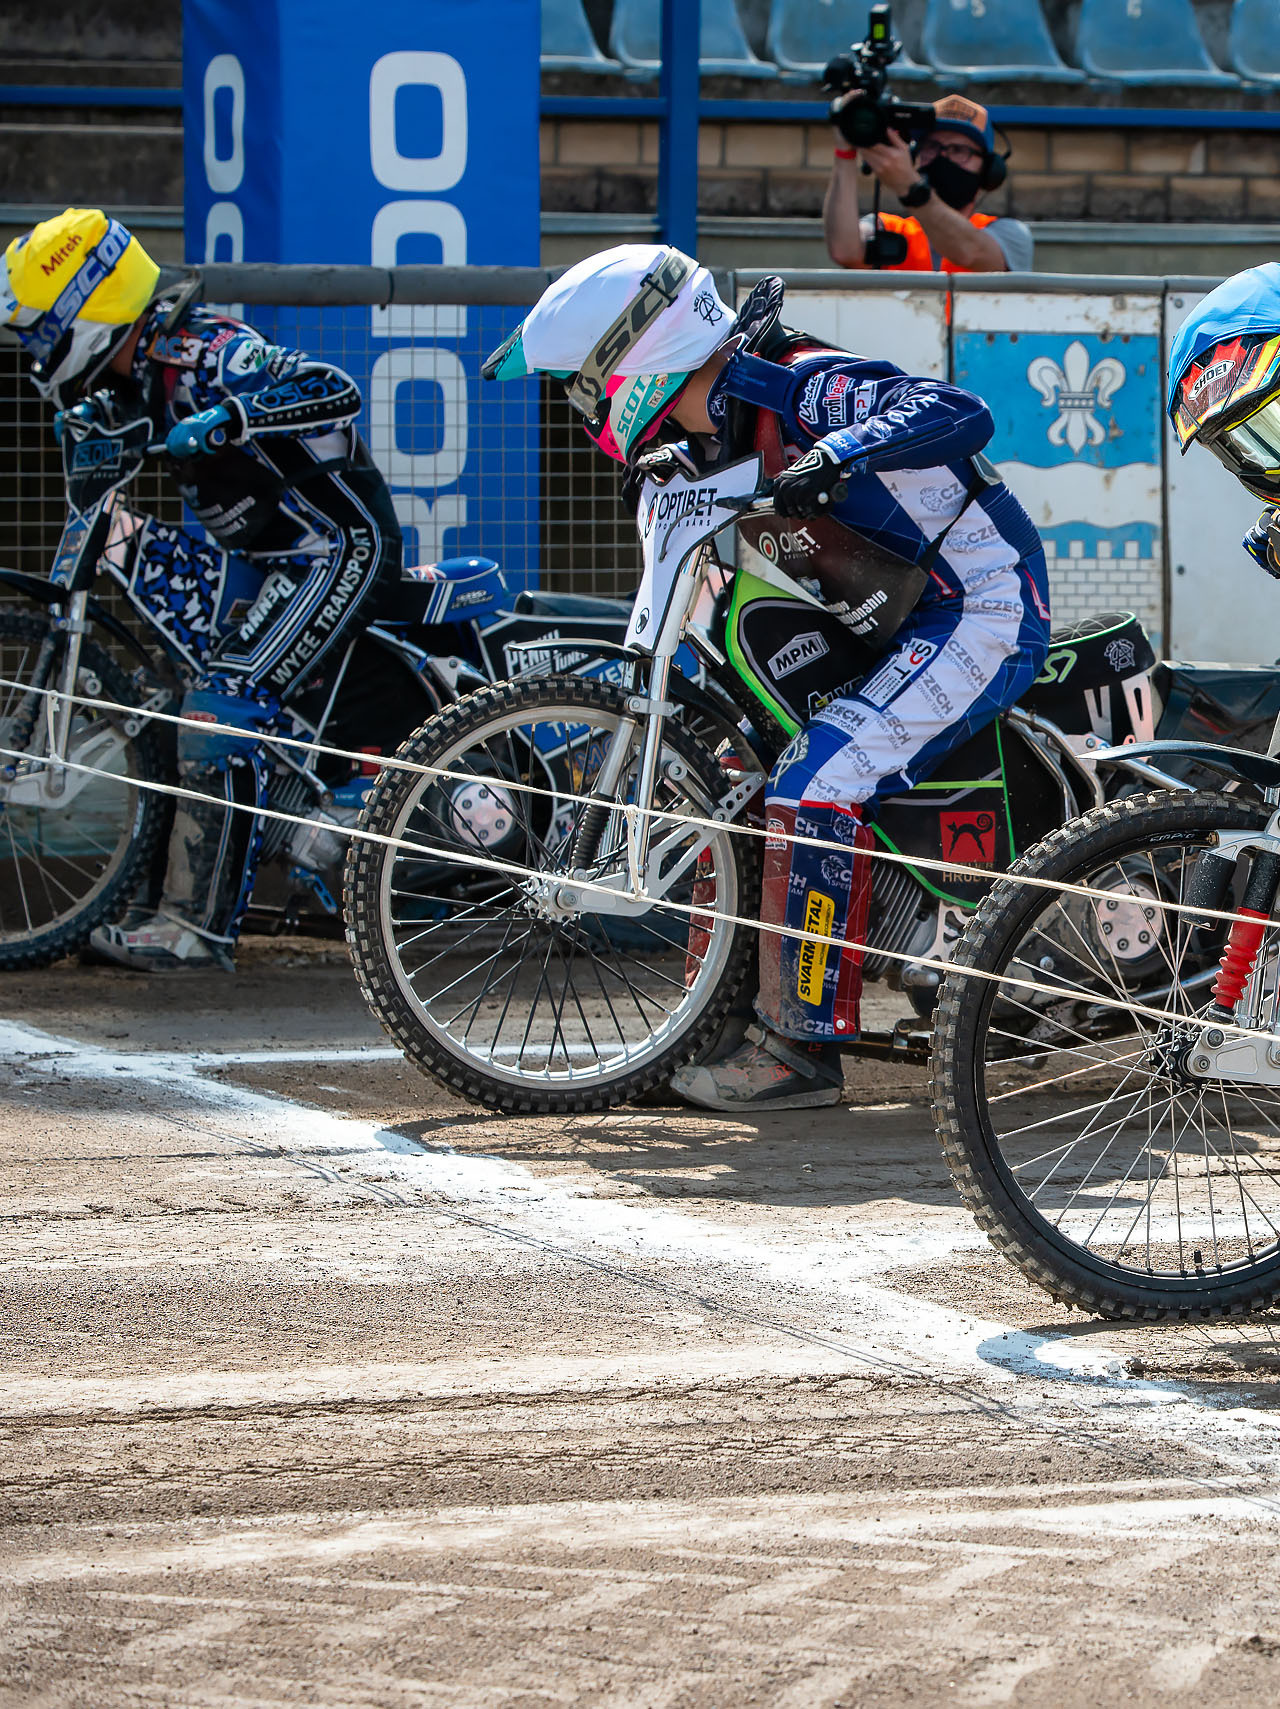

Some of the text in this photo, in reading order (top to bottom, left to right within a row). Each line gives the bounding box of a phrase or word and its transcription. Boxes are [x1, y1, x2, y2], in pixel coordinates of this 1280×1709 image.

[41, 234, 82, 276] Mitch
[1193, 363, 1228, 395] SHOEI
[658, 488, 718, 520] OPTIBET
[271, 527, 371, 685] WYEE TRANSPORT
[775, 639, 818, 672] MPM
[947, 640, 988, 687] CZECH
